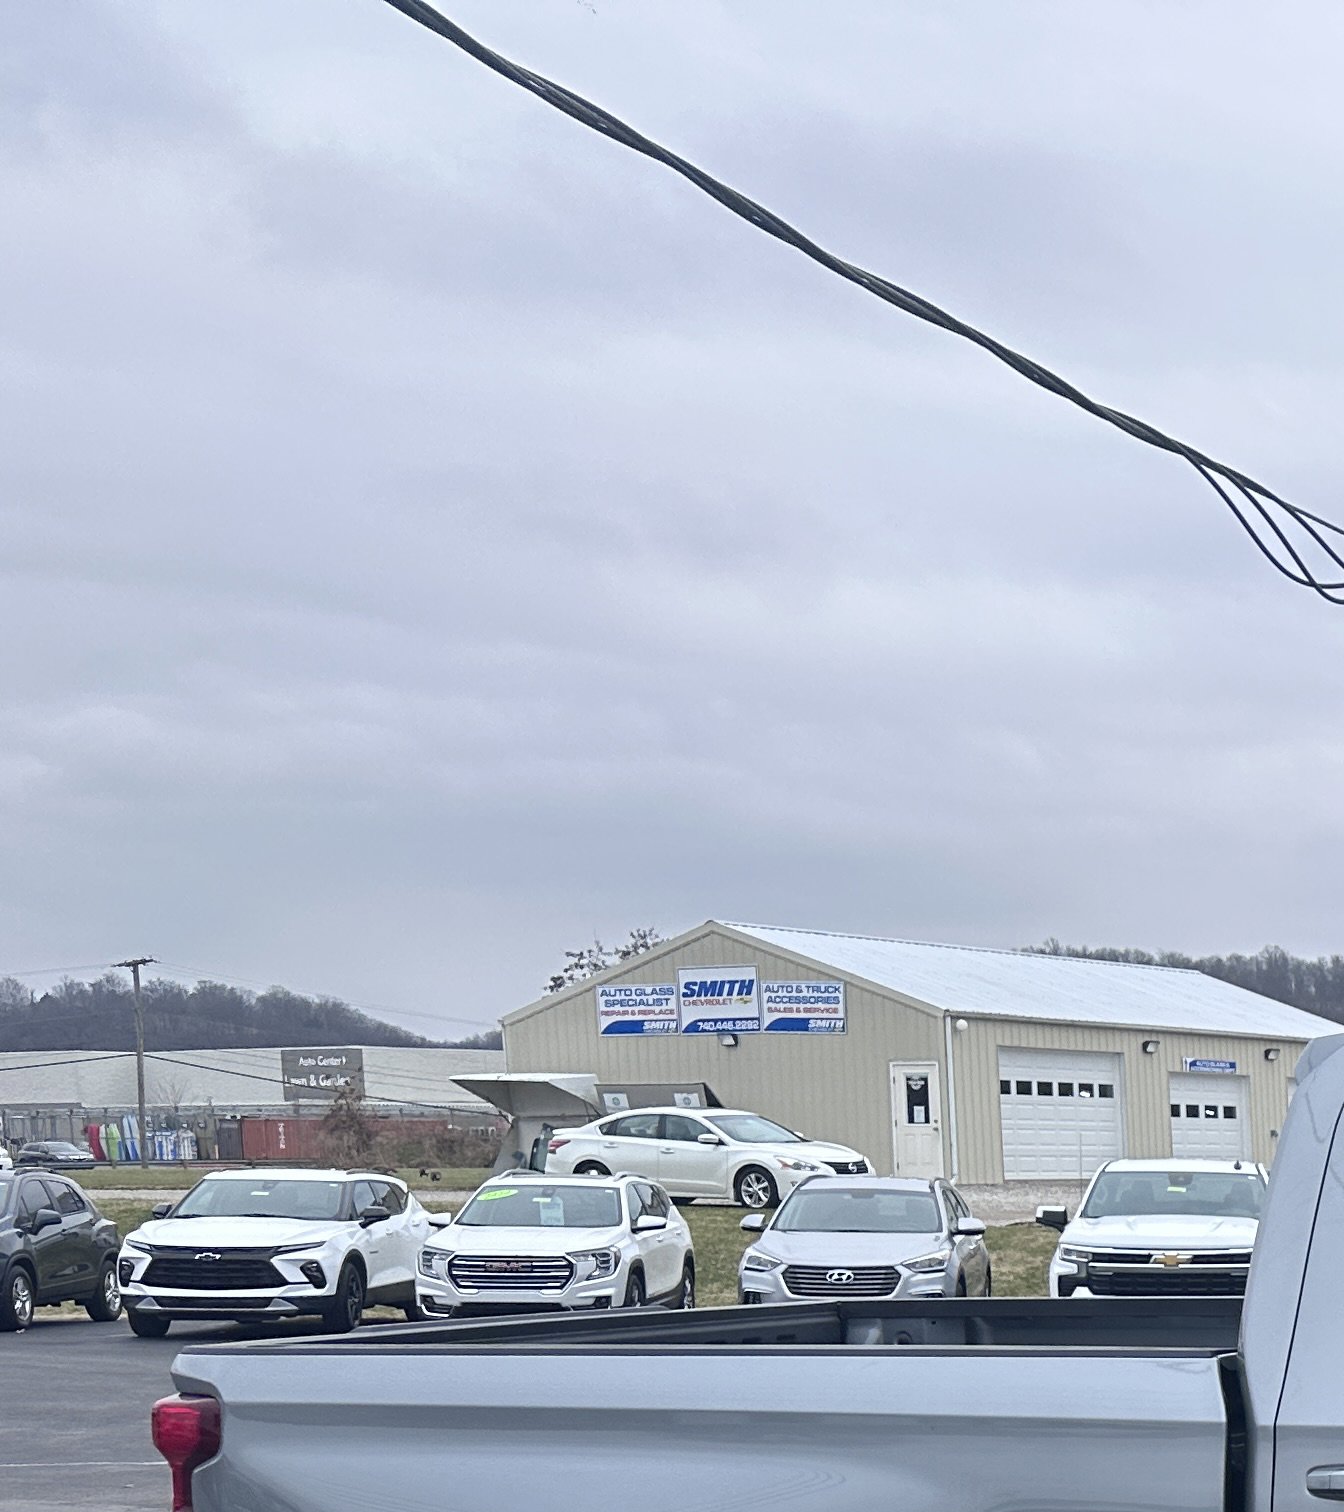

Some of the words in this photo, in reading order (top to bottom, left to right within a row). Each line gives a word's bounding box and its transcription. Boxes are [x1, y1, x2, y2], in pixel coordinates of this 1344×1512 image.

[600, 988, 632, 997] AUTO
[635, 987, 674, 996] GLASS
[682, 979, 755, 998] SMITH
[764, 985, 793, 993] AUTO
[805, 985, 841, 994] TRUCK
[604, 998, 670, 1007] SPECIALIST
[767, 995, 840, 1004] ACCESSORIES
[643, 1020, 677, 1030] SMITH
[808, 1019, 843, 1028] SMITH
[317, 1056, 342, 1066] Center
